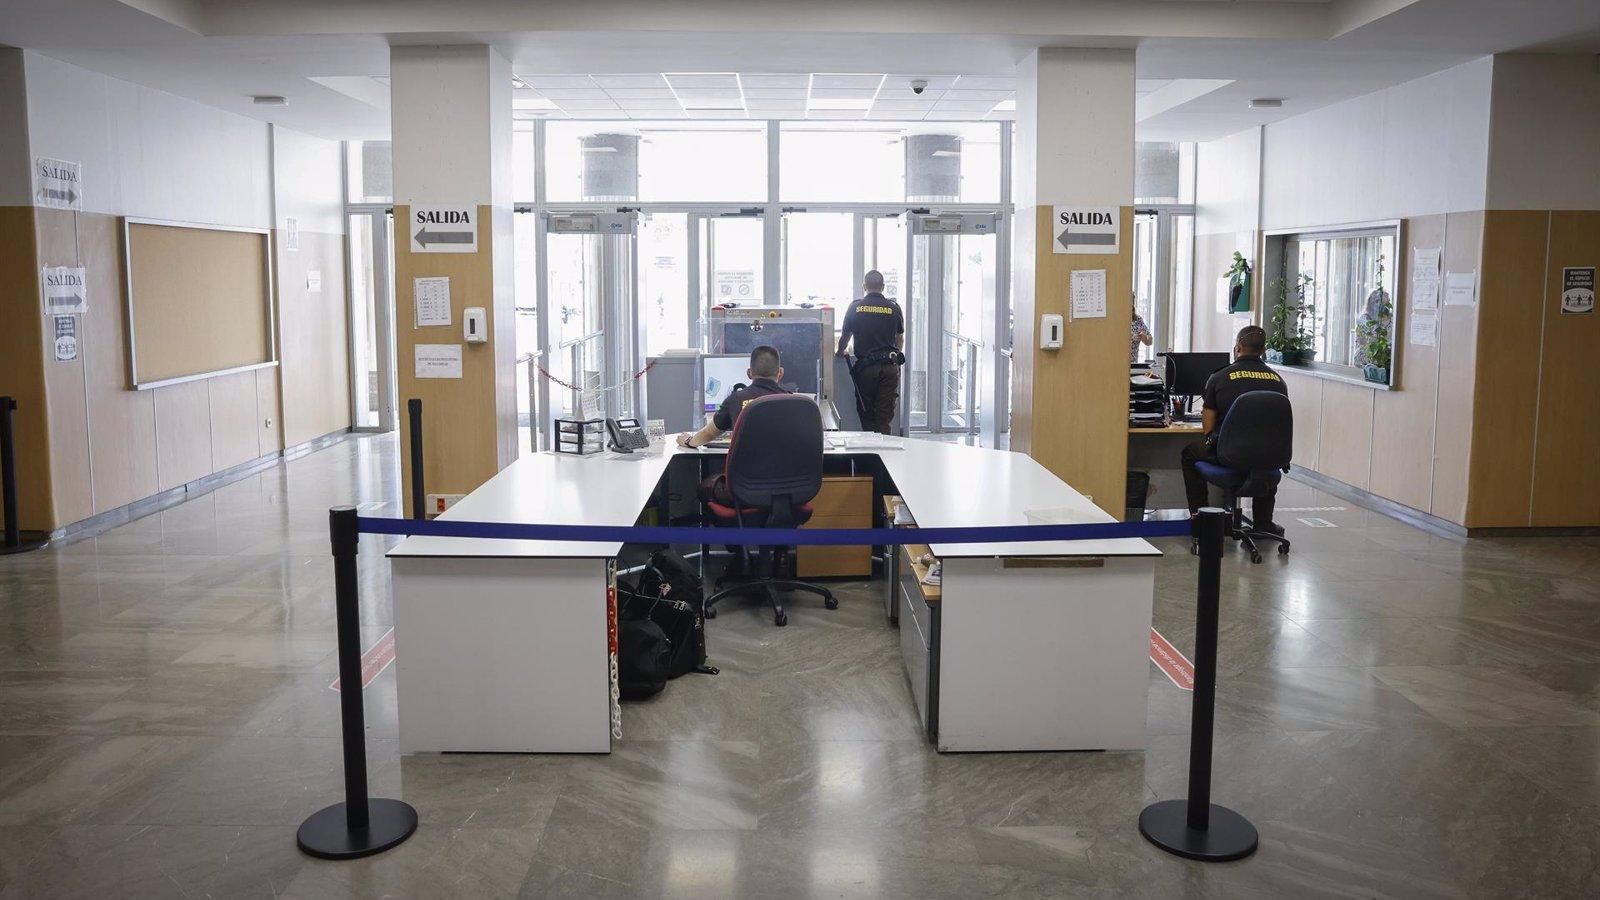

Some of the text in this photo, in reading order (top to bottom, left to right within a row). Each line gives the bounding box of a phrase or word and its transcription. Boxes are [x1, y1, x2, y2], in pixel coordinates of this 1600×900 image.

[42, 166, 77, 182] SALIDA
[416, 211, 470, 224] SALIDA
[1060, 212, 1113, 225] SALIDA
[47, 275, 83, 287] SALIDA
[856, 305, 892, 314] SEGURIDAD
